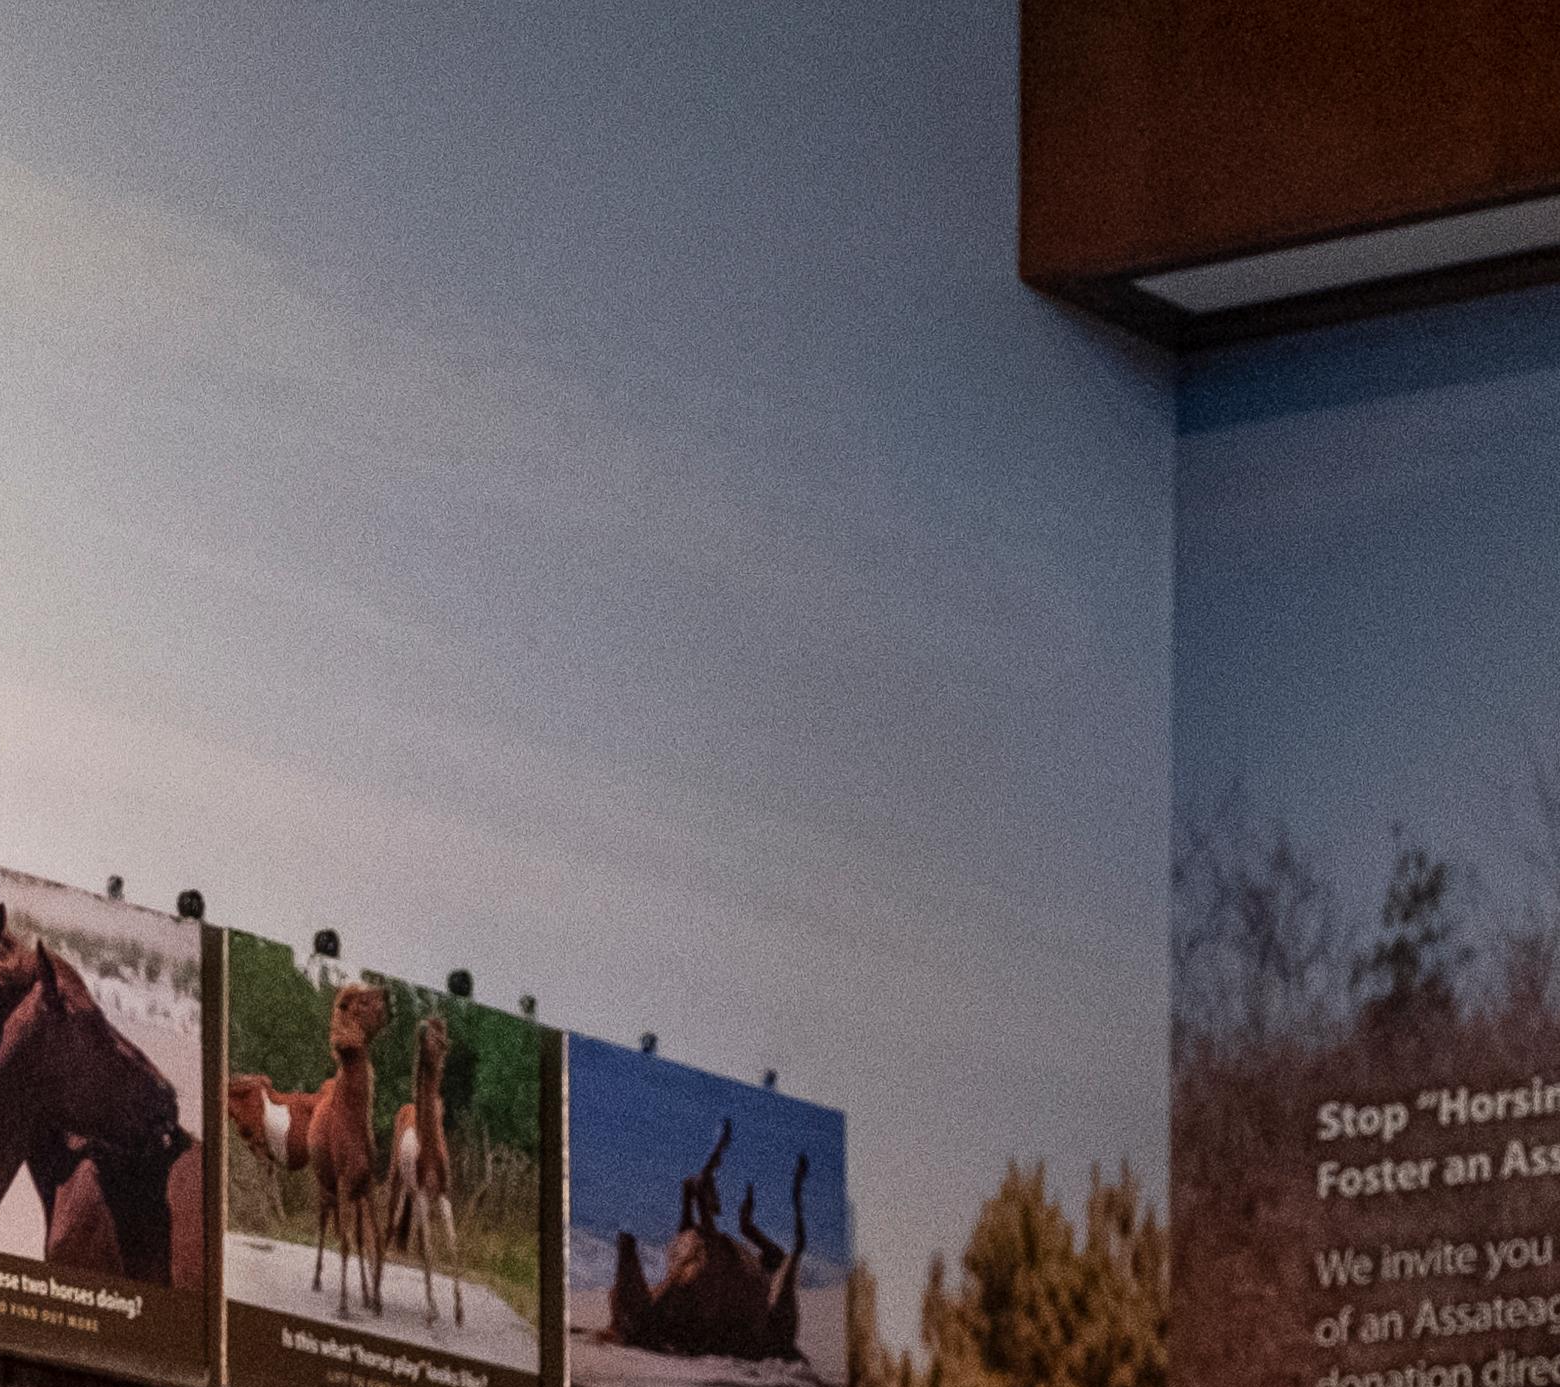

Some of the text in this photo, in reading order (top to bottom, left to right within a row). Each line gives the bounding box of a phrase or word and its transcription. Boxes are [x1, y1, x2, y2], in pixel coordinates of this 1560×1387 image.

[1318, 1101, 1407, 1143] Stop
[1316, 1158, 1436, 1200] Foster
[1445, 1153, 1491, 1185] an
[1315, 1247, 1372, 1289] We
[1381, 1244, 1477, 1280] invite
[1485, 1234, 1554, 1281] you
[21, 1273, 49, 1296] two
[49, 1275, 96, 1307] horses
[96, 1287, 143, 1320] doing?
[1313, 1303, 1354, 1349] of
[1361, 1309, 1404, 1342] an
